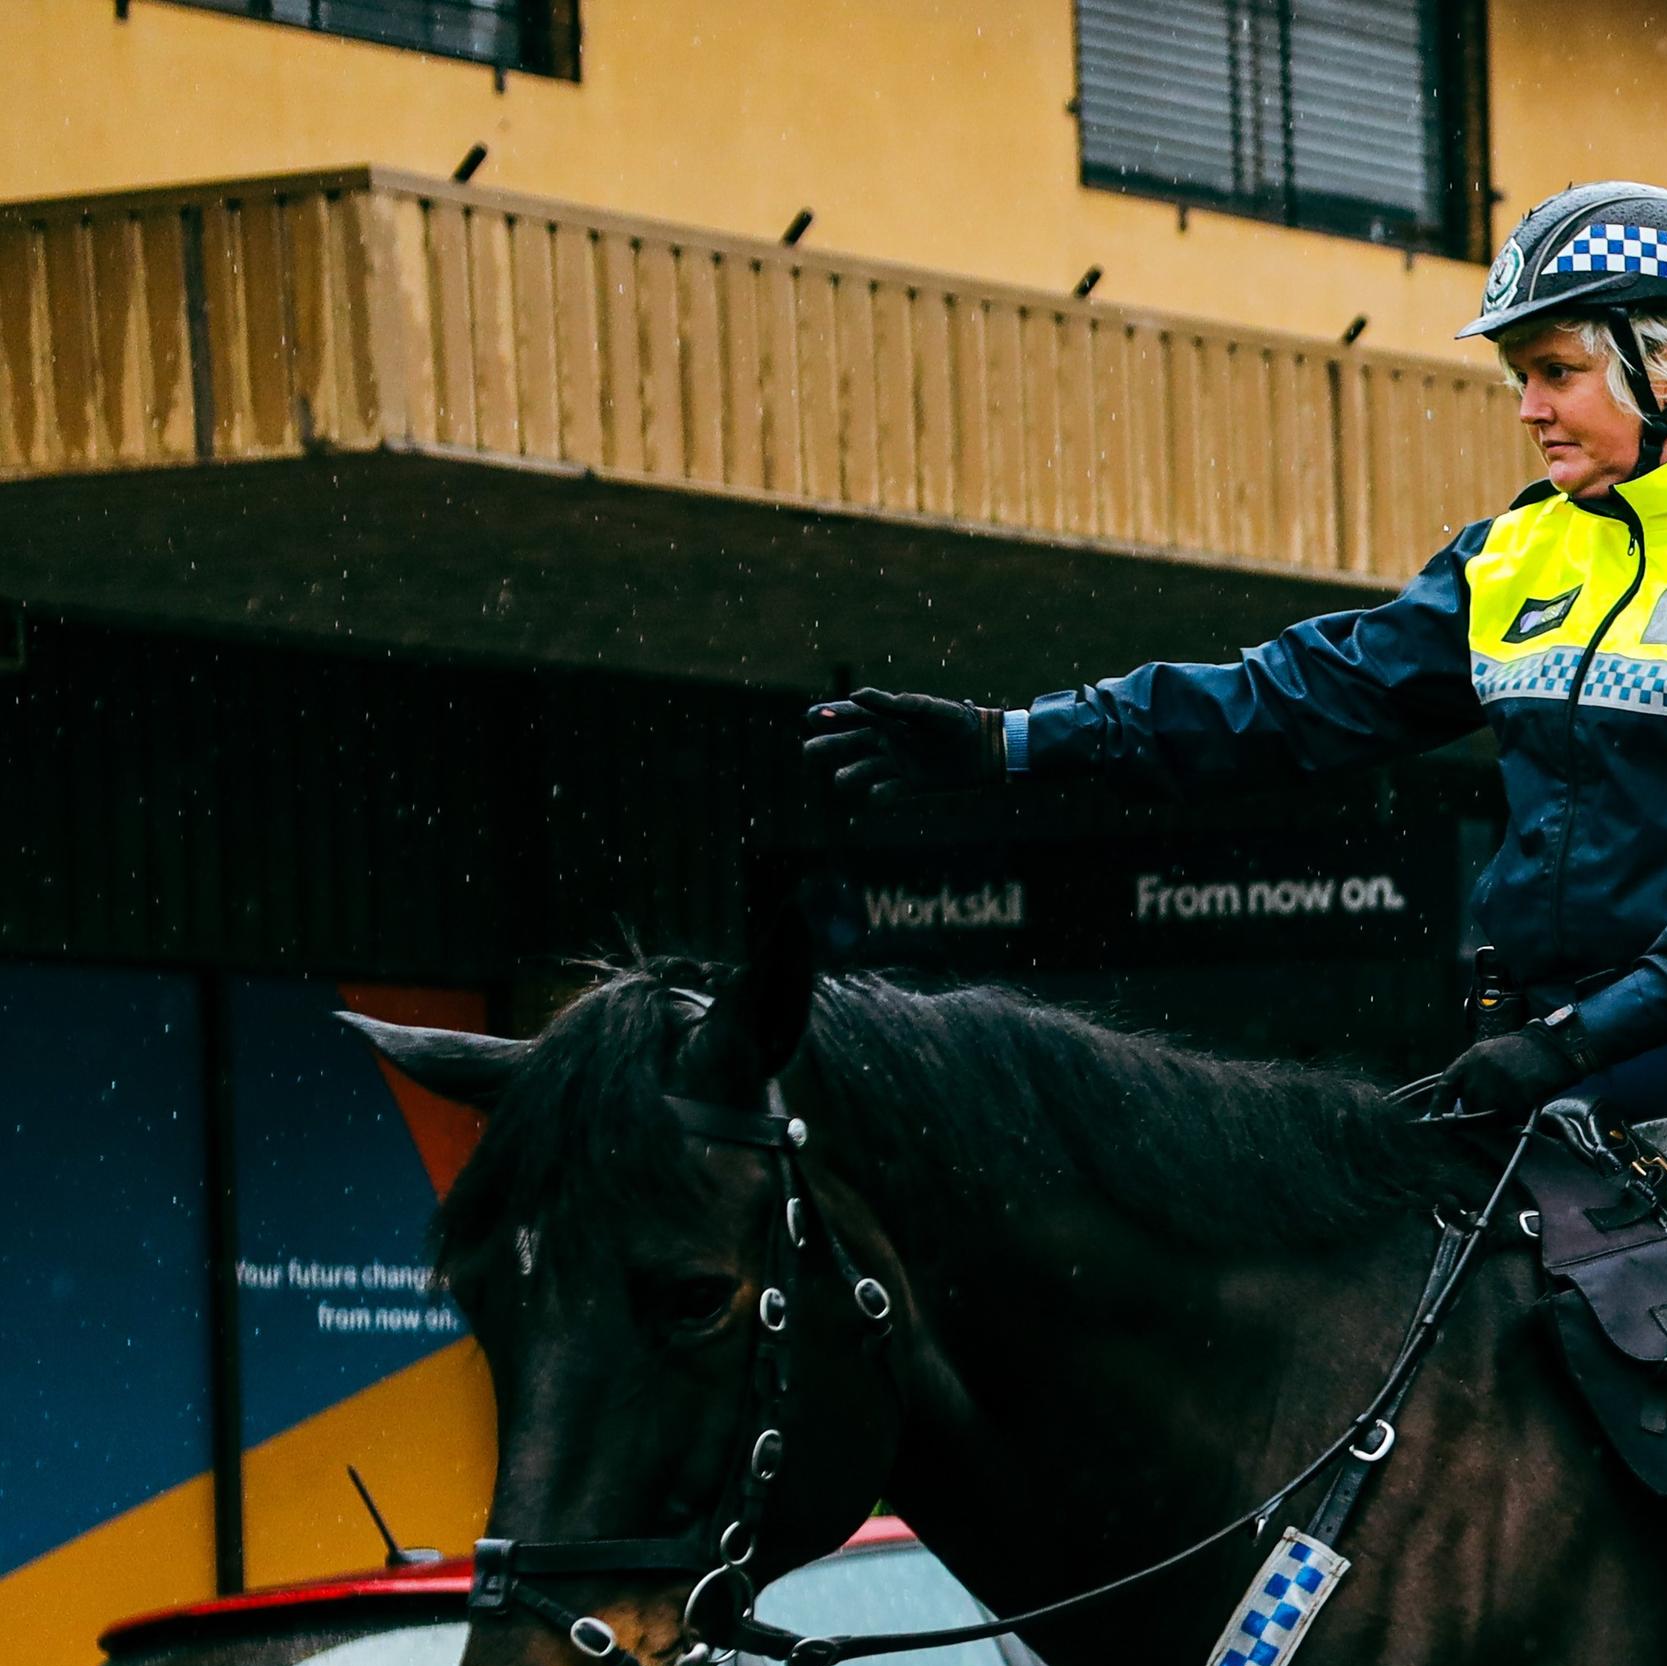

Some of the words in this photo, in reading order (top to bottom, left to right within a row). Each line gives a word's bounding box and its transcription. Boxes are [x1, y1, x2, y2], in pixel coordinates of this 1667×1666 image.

[1136, 874, 1241, 918] From
[1249, 879, 1336, 914] now
[1340, 875, 1404, 911] on.
[288, 1257, 357, 1289] future
[318, 1301, 371, 1332] from
[376, 1306, 420, 1332] now
